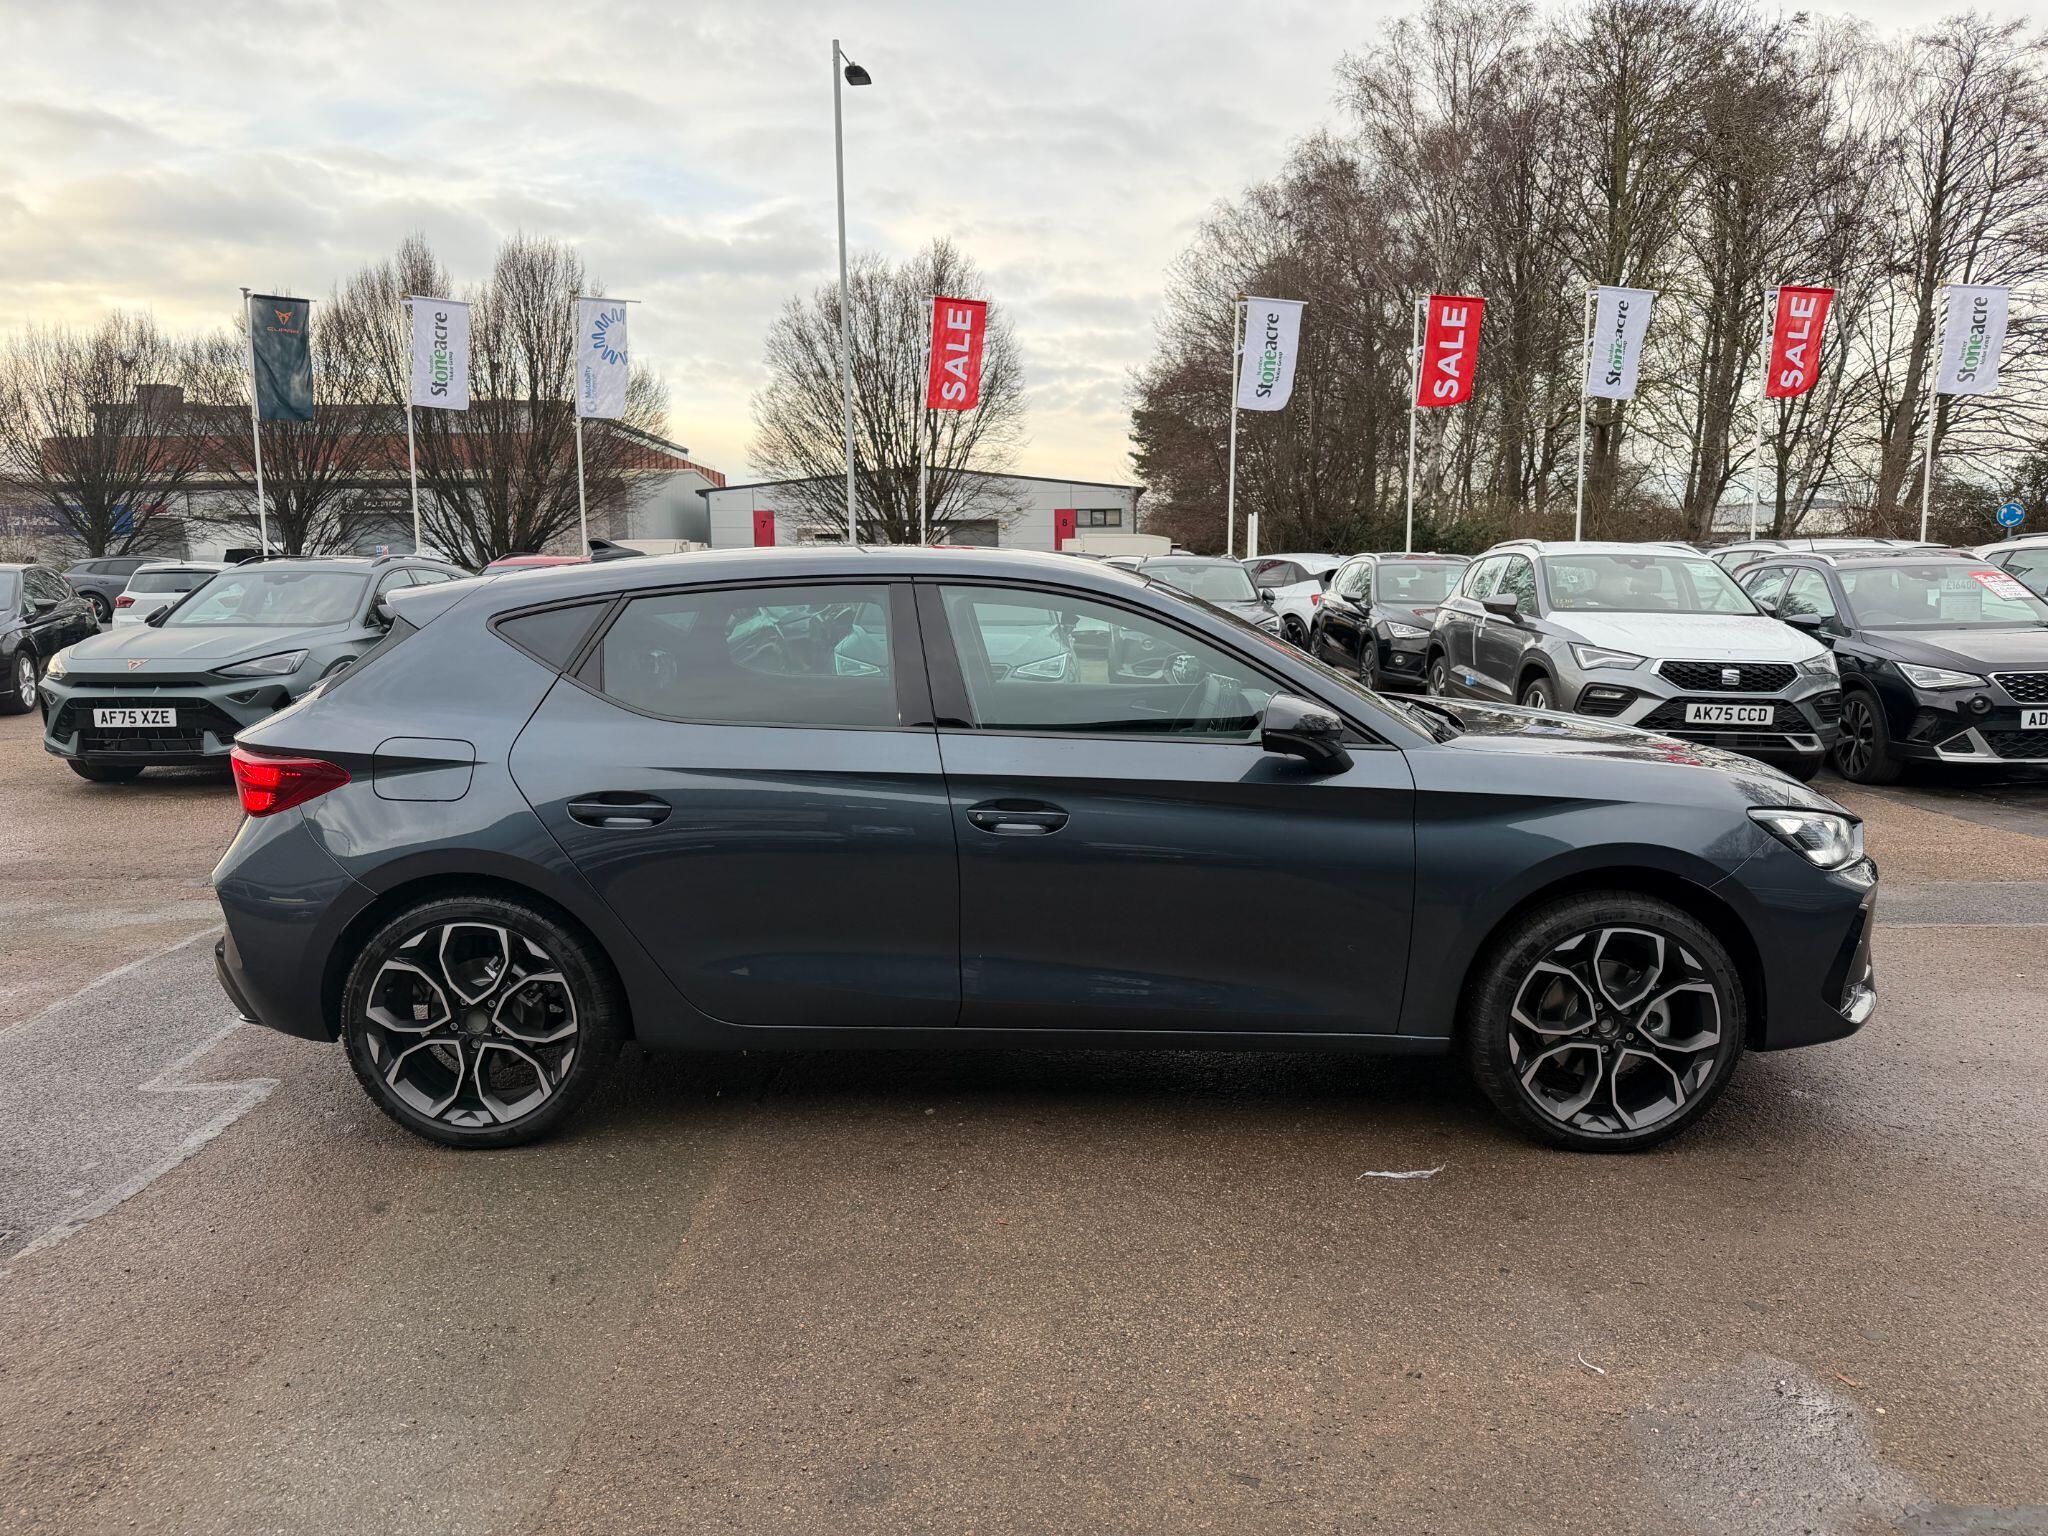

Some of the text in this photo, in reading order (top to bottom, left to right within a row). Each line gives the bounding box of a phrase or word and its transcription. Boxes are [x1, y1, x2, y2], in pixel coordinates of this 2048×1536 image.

[430, 311, 449, 397] Stoneacre
[941, 308, 972, 402] SALE
[1255, 313, 1279, 398] Stoneacre
[1433, 306, 1468, 399] SALE
[1605, 300, 1629, 386] Stoneacre
[1780, 296, 1817, 388] SALE
[1956, 296, 1988, 383] Stoneacre
[761, 520, 767, 529] 7
[1062, 518, 1068, 527] 8
[100, 710, 170, 725] AF75 XZE
[1693, 706, 1767, 722] AK75 CCD
[2029, 712, 2048, 726] AD
